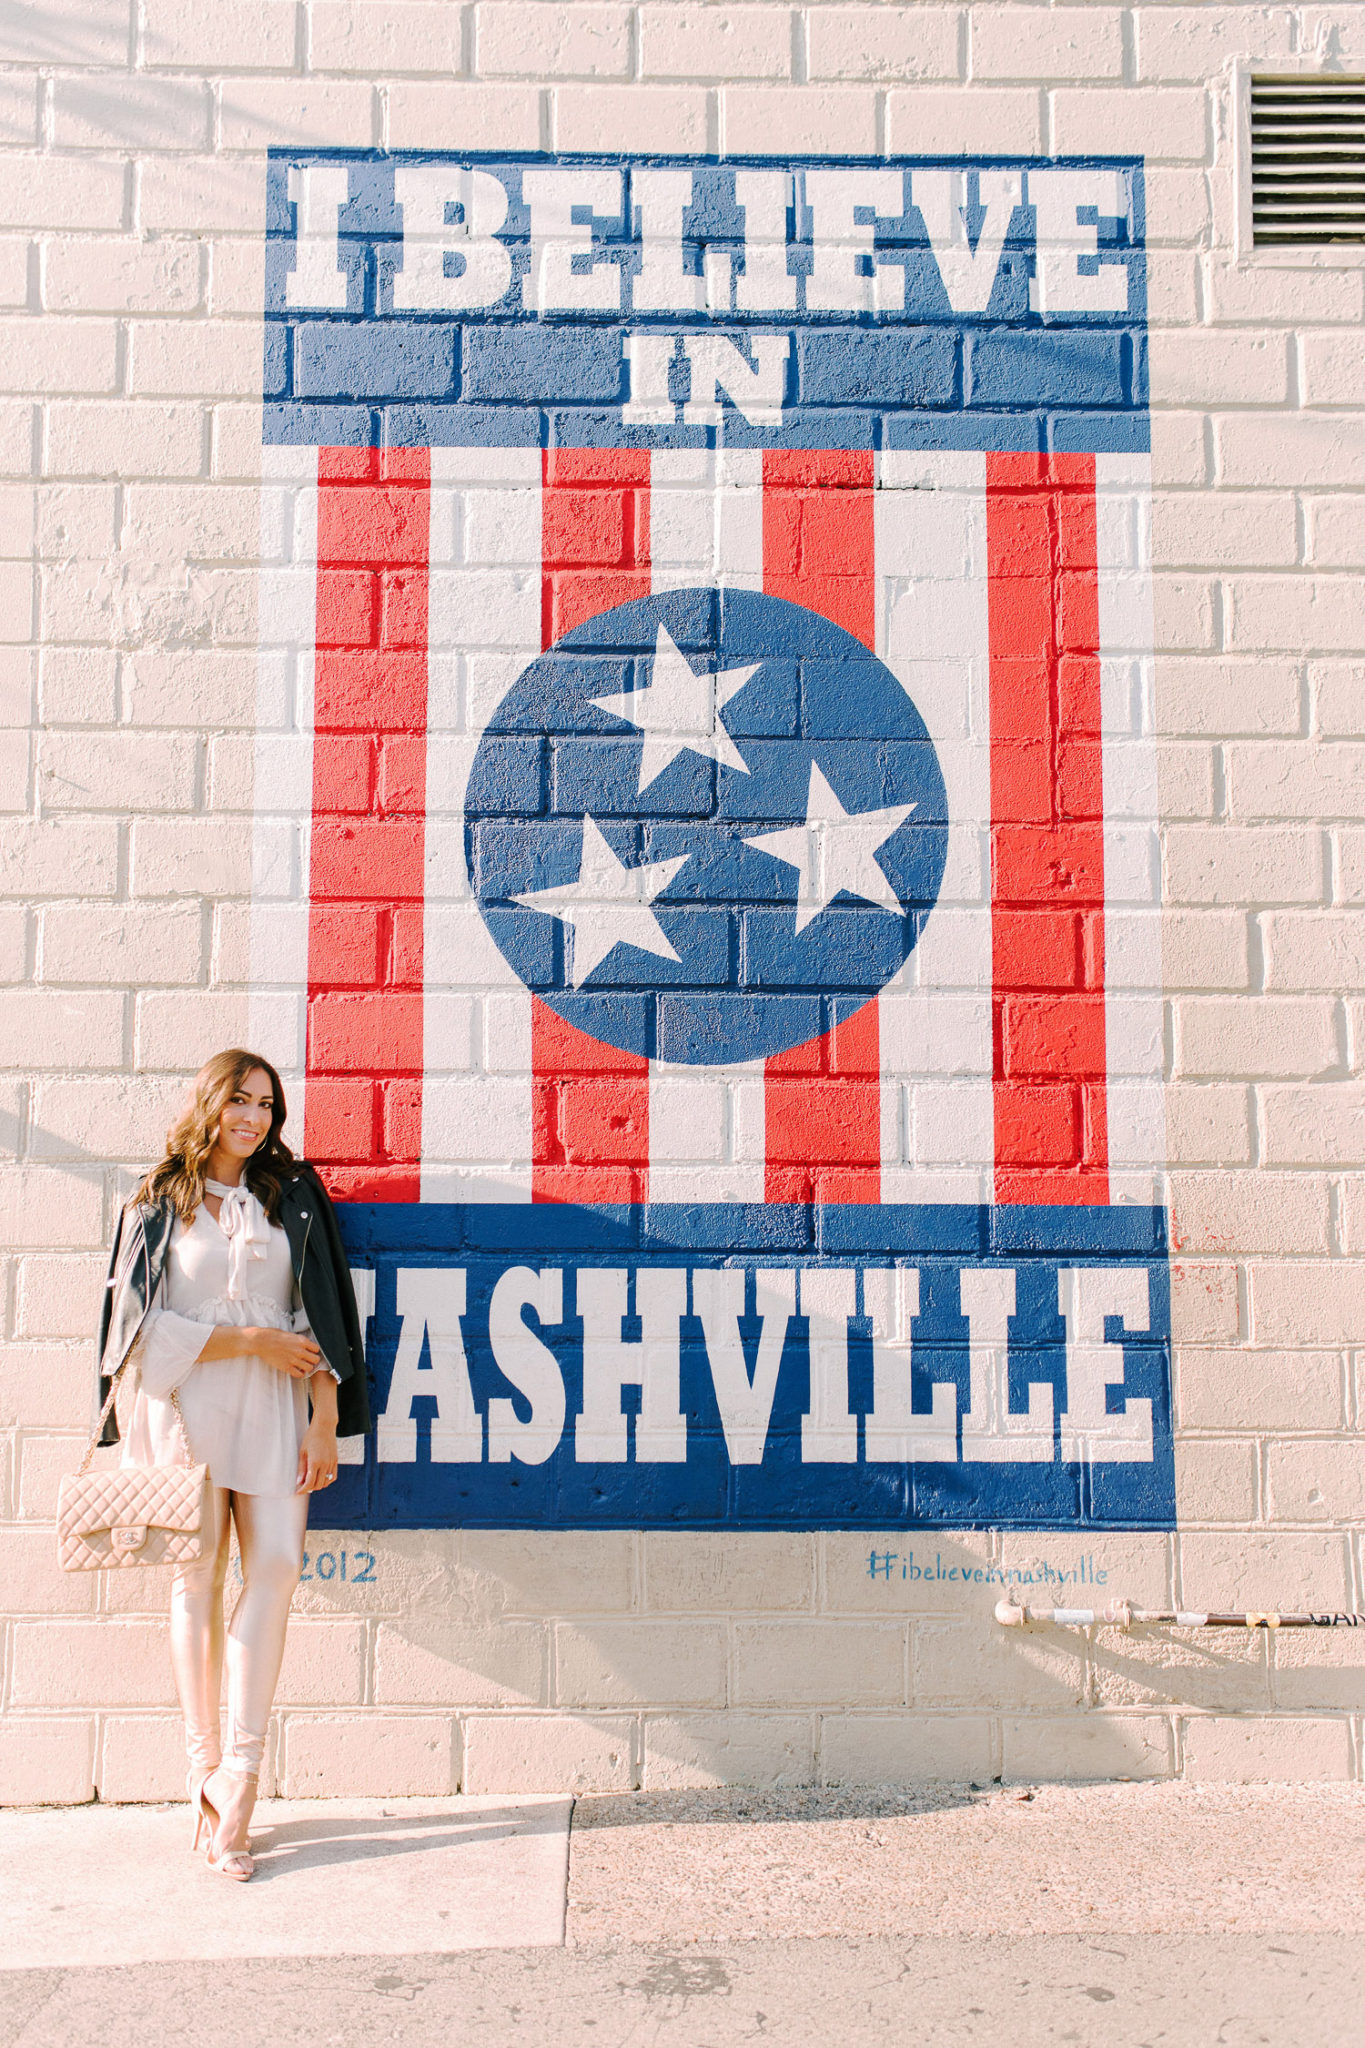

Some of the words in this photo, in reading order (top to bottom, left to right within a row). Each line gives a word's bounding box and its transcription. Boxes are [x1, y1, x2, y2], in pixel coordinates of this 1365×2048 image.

[286, 167, 349, 309] I
[393, 167, 1129, 313] BELIEVE
[622, 335, 790, 427] IN
